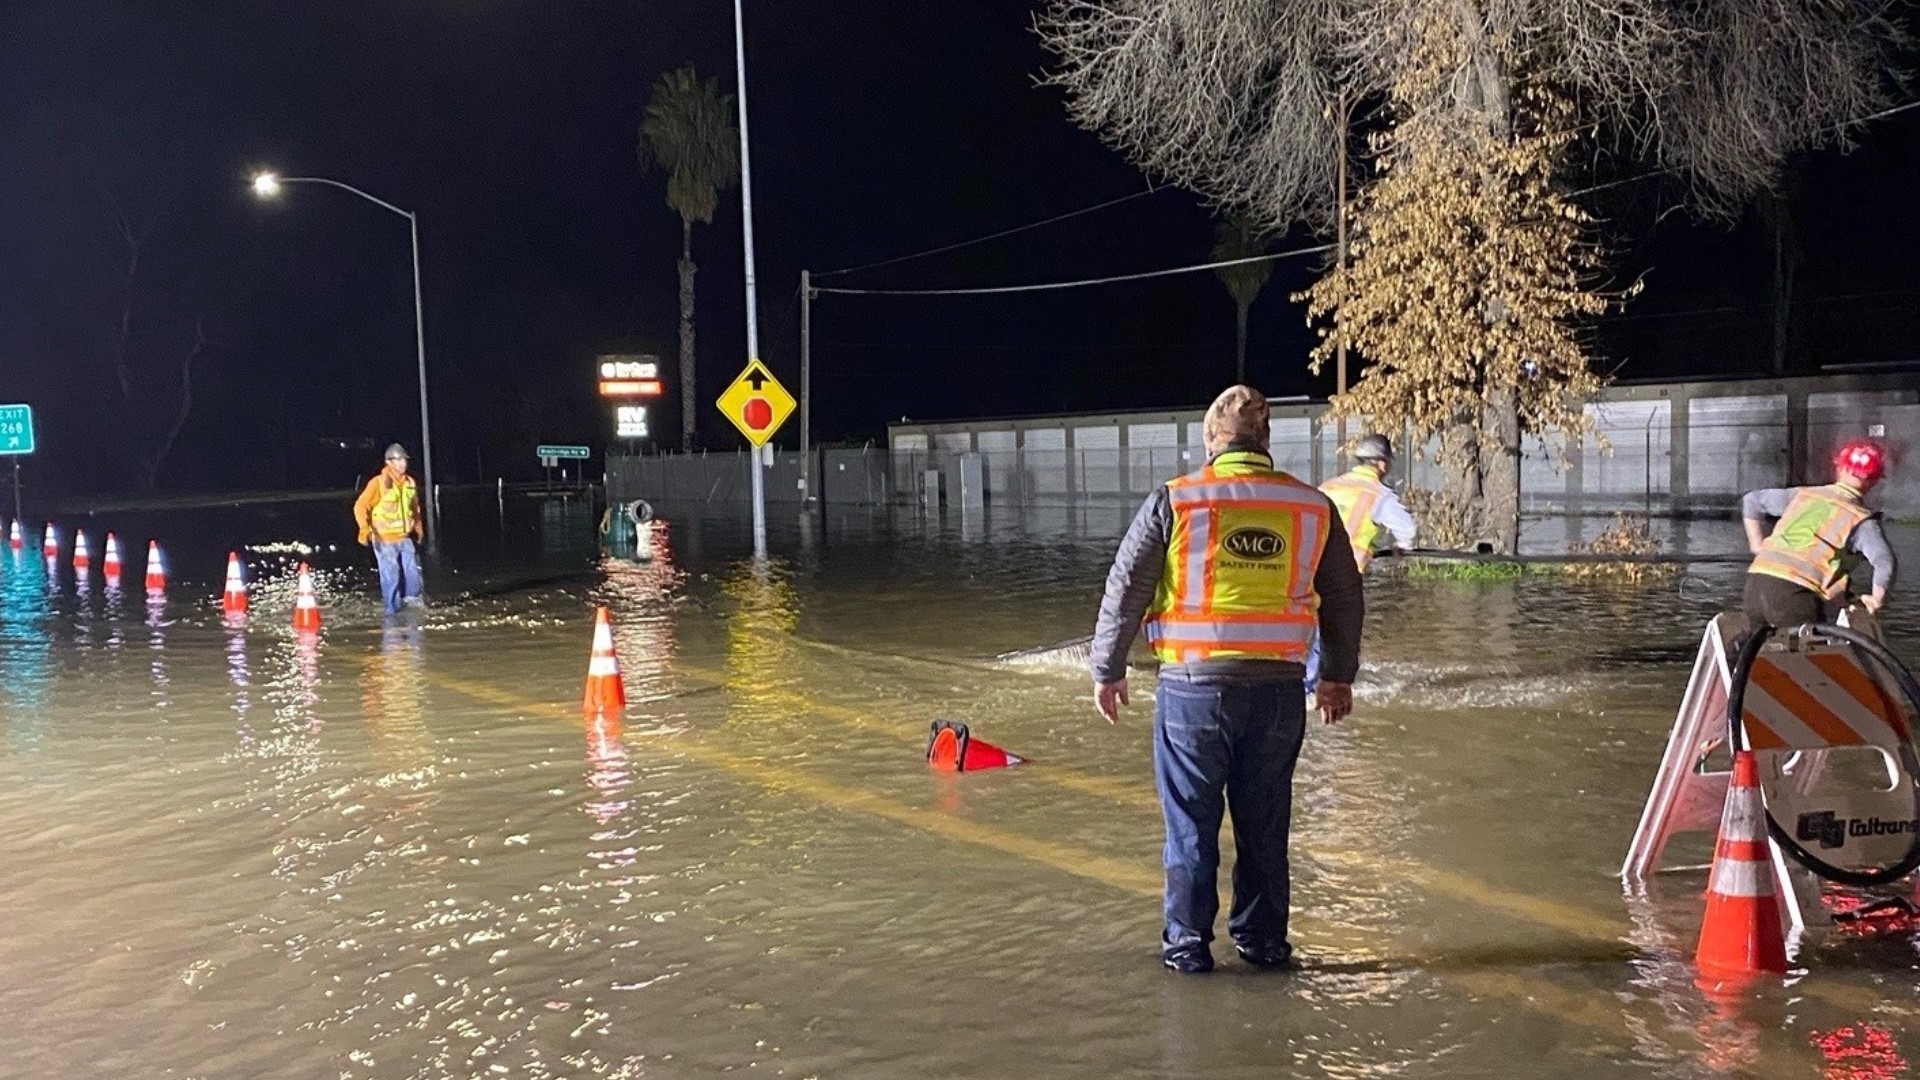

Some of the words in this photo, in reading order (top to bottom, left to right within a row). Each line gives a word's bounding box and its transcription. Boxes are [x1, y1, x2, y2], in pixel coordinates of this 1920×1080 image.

[1, 422, 23, 434] 268
[1231, 535, 1280, 553] SMCI
[1220, 560, 1255, 569] SAFETY
